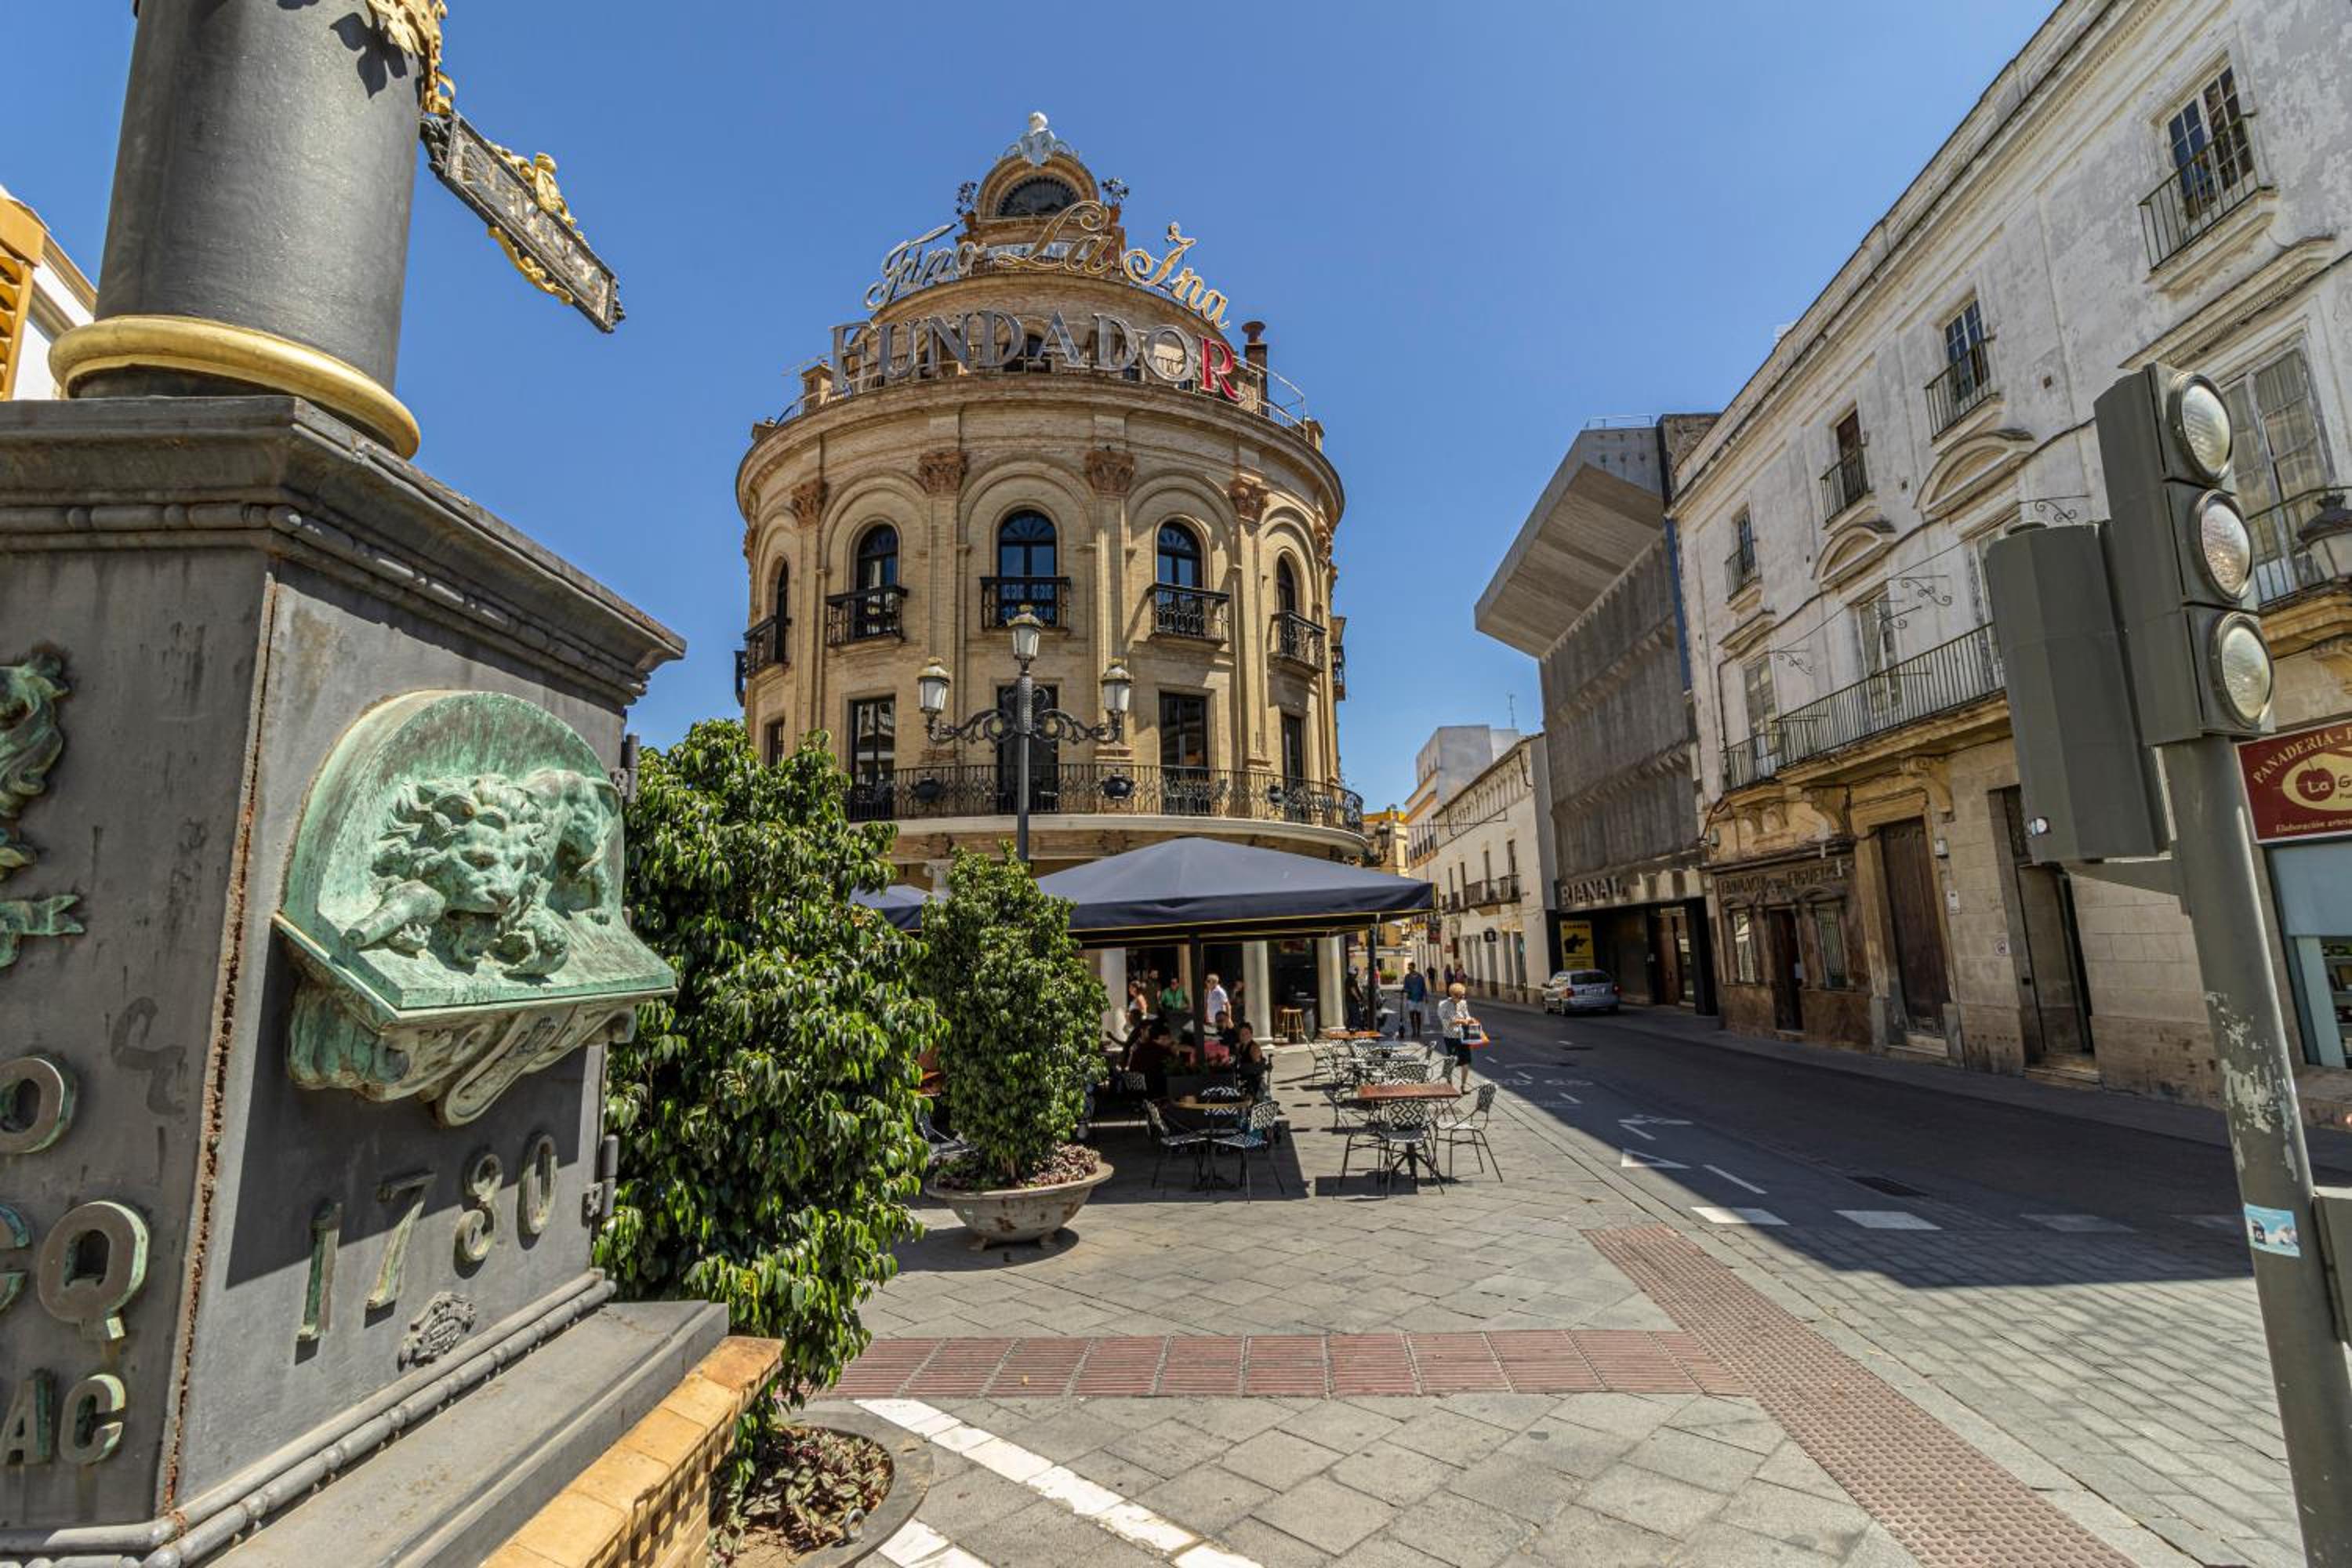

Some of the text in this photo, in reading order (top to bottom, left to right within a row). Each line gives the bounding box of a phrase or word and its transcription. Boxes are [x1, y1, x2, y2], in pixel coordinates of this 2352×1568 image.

[865, 200, 1230, 329] Fino La Ina
[829, 310, 1247, 402] FUNDADOR
[2253, 731, 2334, 783] PANADERIA
[2307, 780, 2330, 793] La
[296, 1134, 559, 1341] 1780
